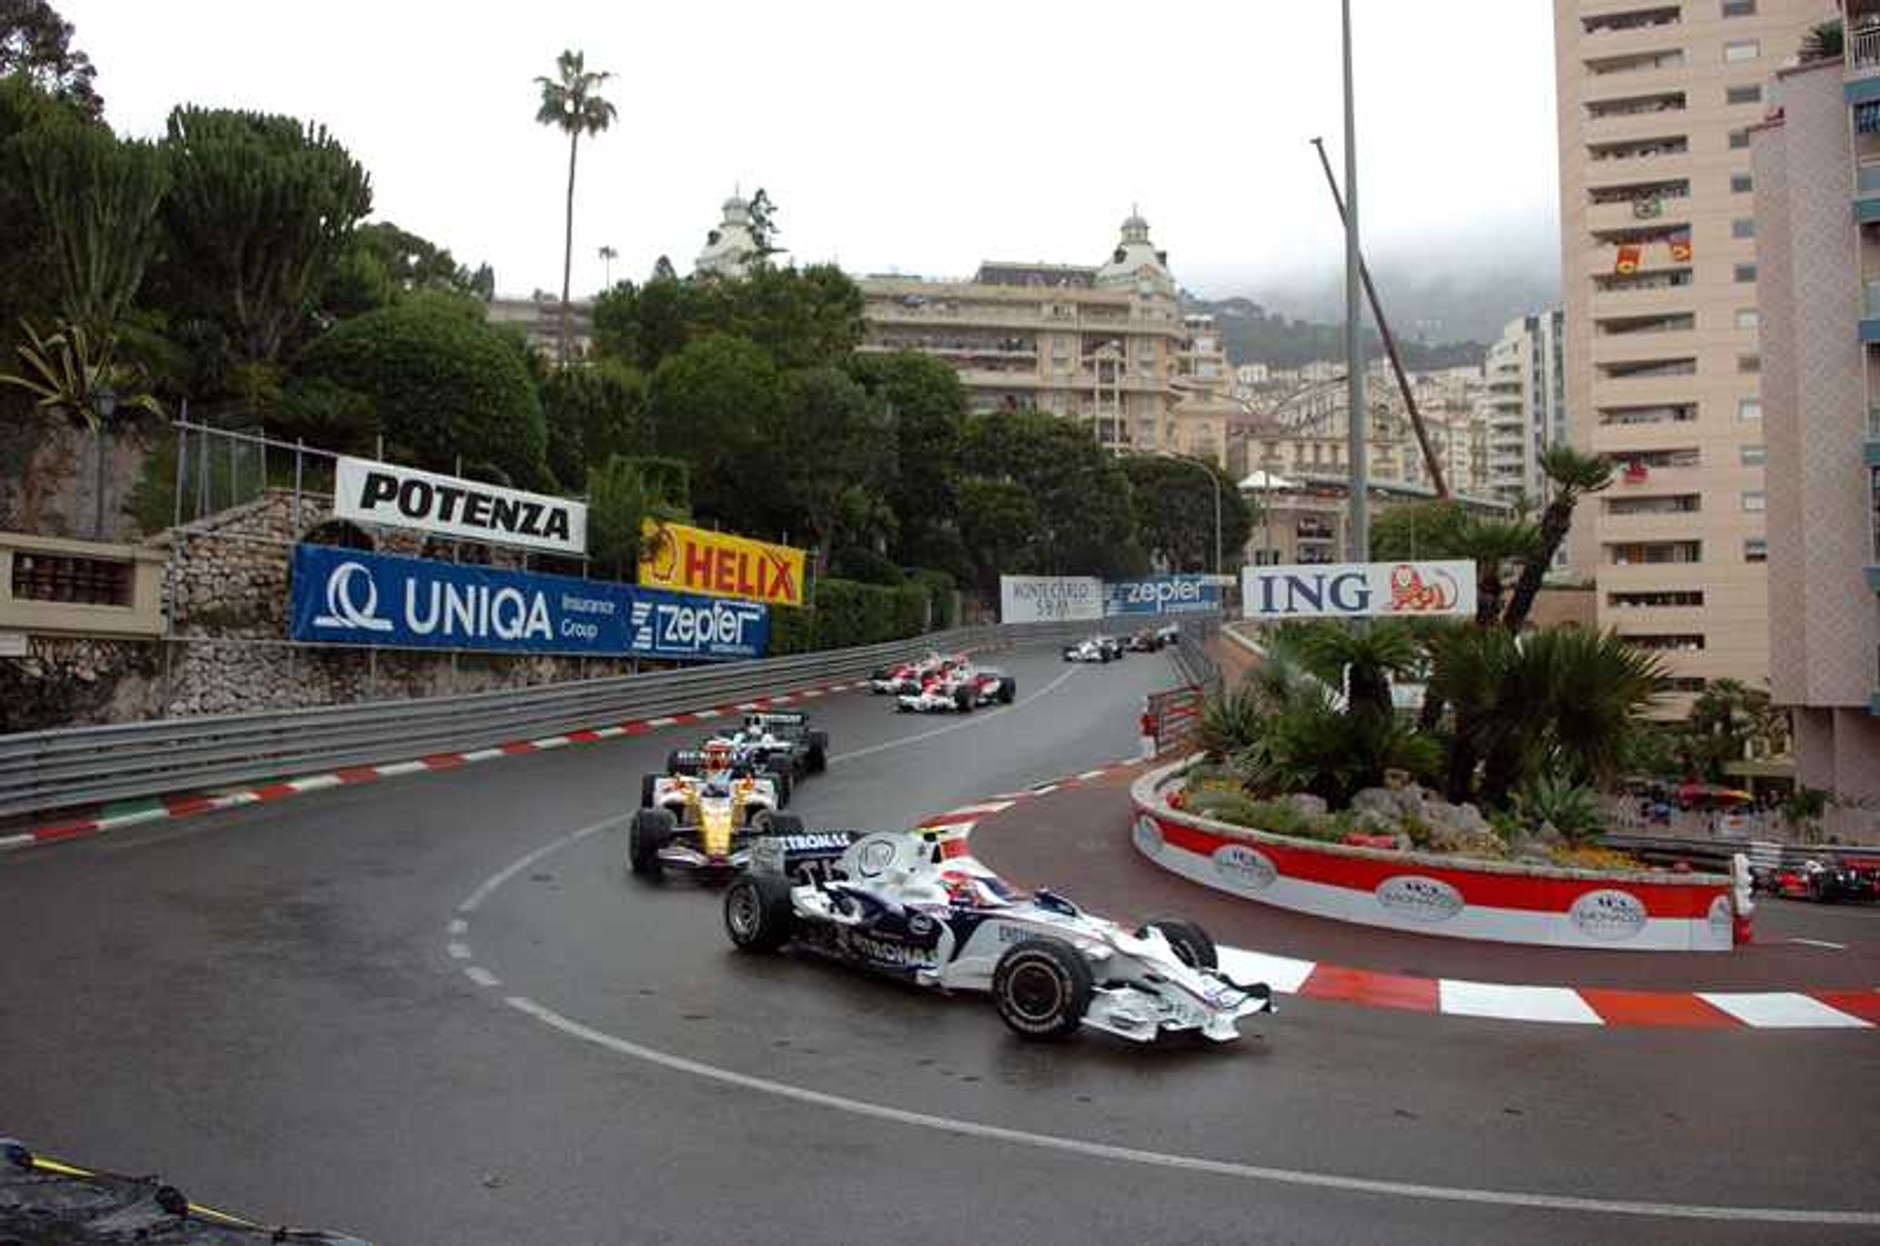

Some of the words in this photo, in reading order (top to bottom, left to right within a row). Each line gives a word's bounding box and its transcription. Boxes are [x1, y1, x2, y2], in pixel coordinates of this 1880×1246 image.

[360, 471, 569, 540] POTENZA
[686, 542, 793, 601] HELIX
[1259, 573, 1373, 613] ING
[405, 578, 553, 640] UNIQA
[561, 617, 599, 642] Group
[657, 600, 762, 649] zepter
